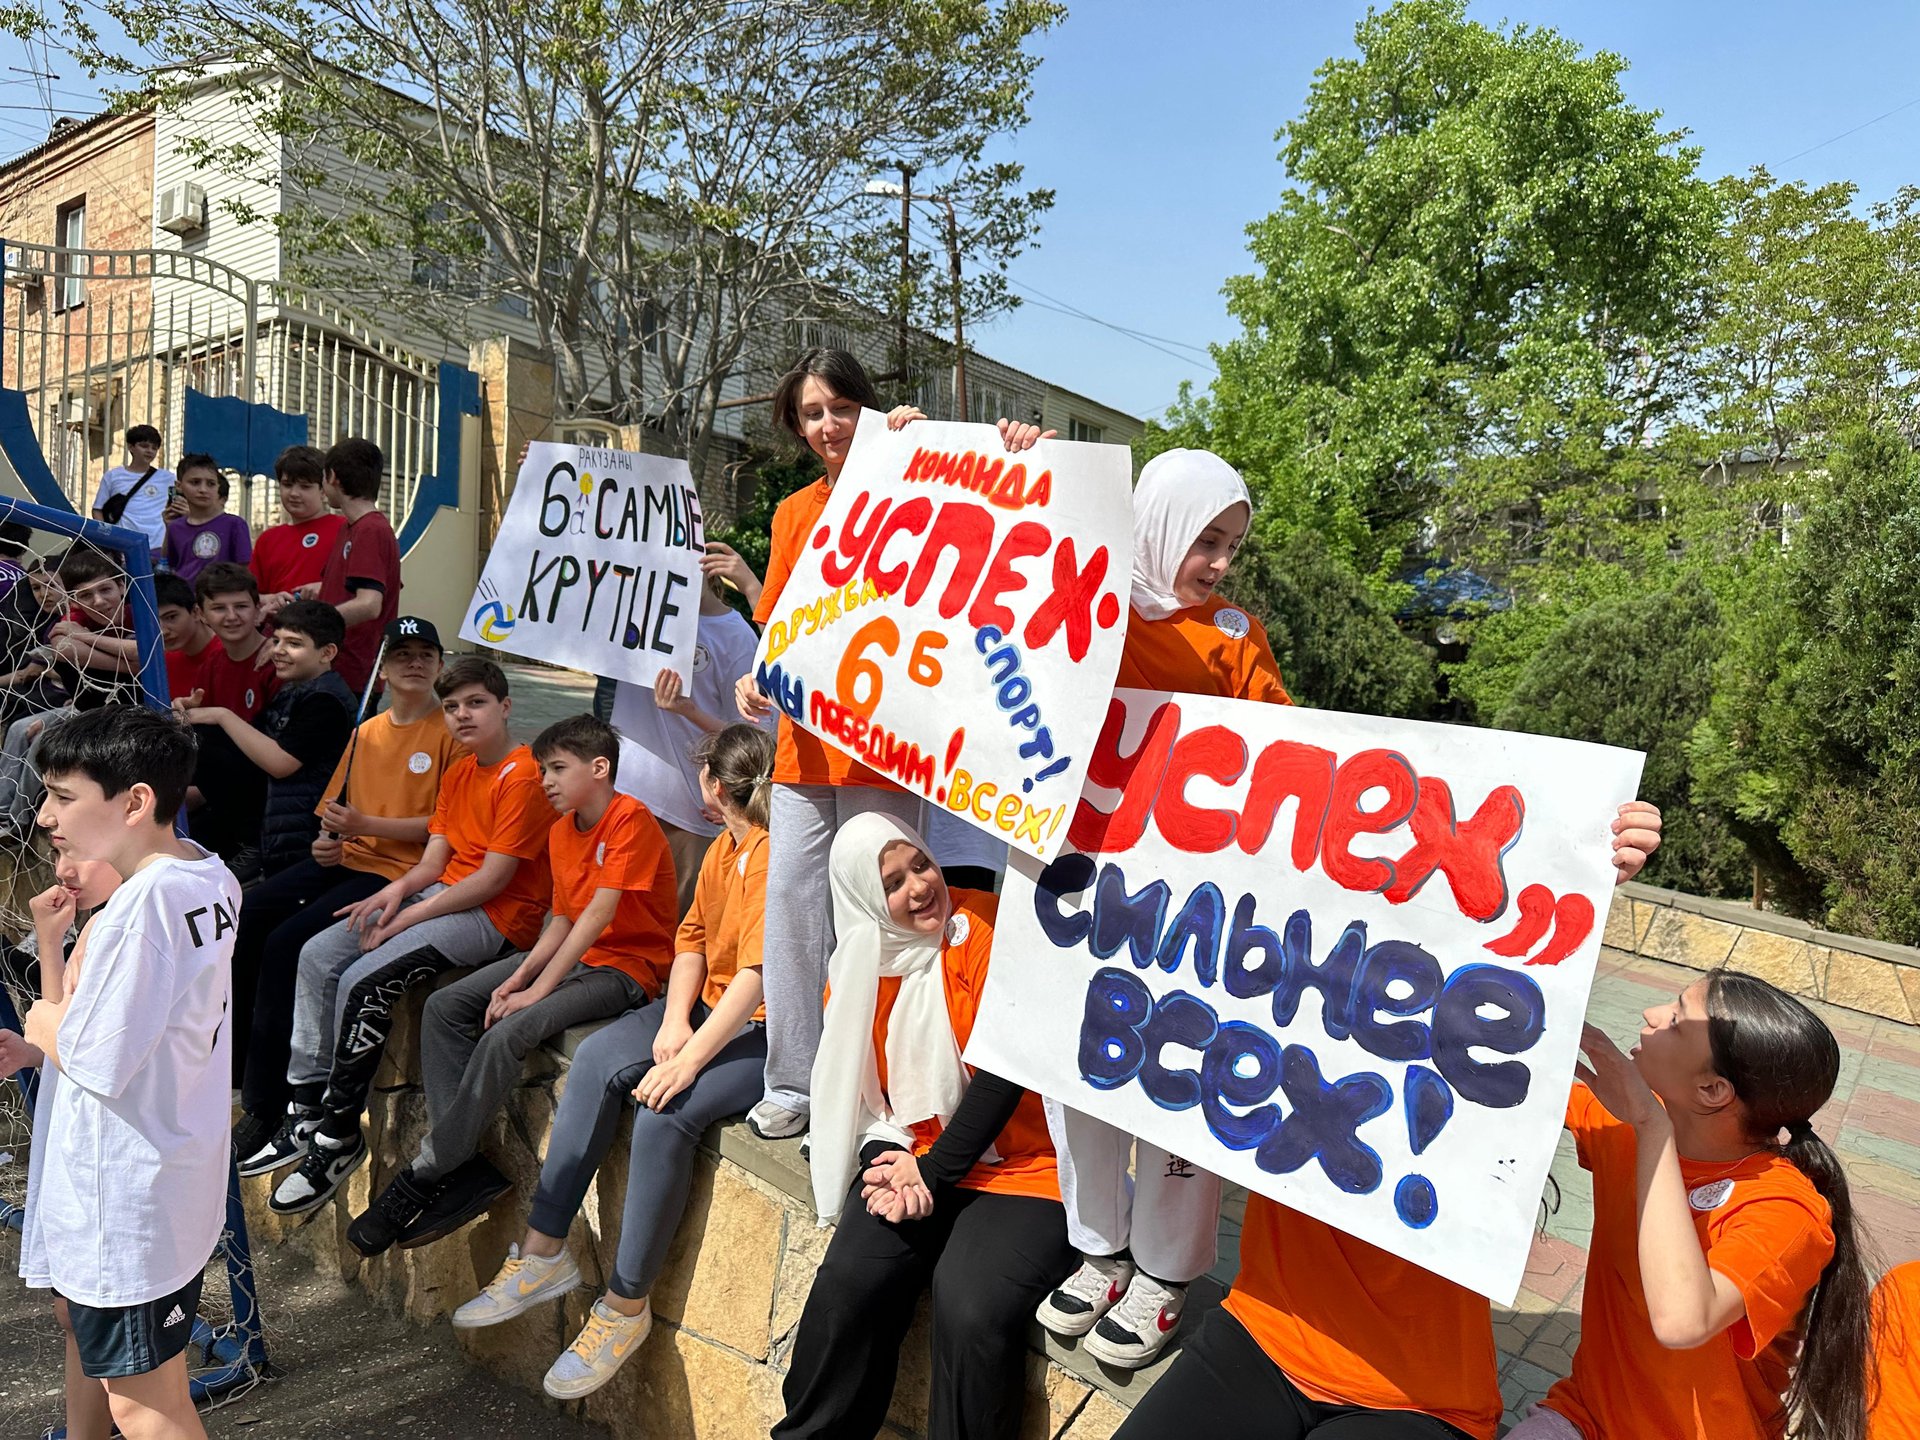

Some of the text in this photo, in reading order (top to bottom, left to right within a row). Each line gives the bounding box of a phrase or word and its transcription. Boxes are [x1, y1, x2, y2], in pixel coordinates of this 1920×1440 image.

[578, 447, 633, 472] РАКУЗАНЫ
[903, 445, 1053, 511] КОМАНДА
[594, 477, 705, 553] САМЫЕ
[517, 549, 688, 655] КРУТЫЕ
[755, 660, 805, 724] МЫ
[974, 623, 1073, 794] СПОРТ!
